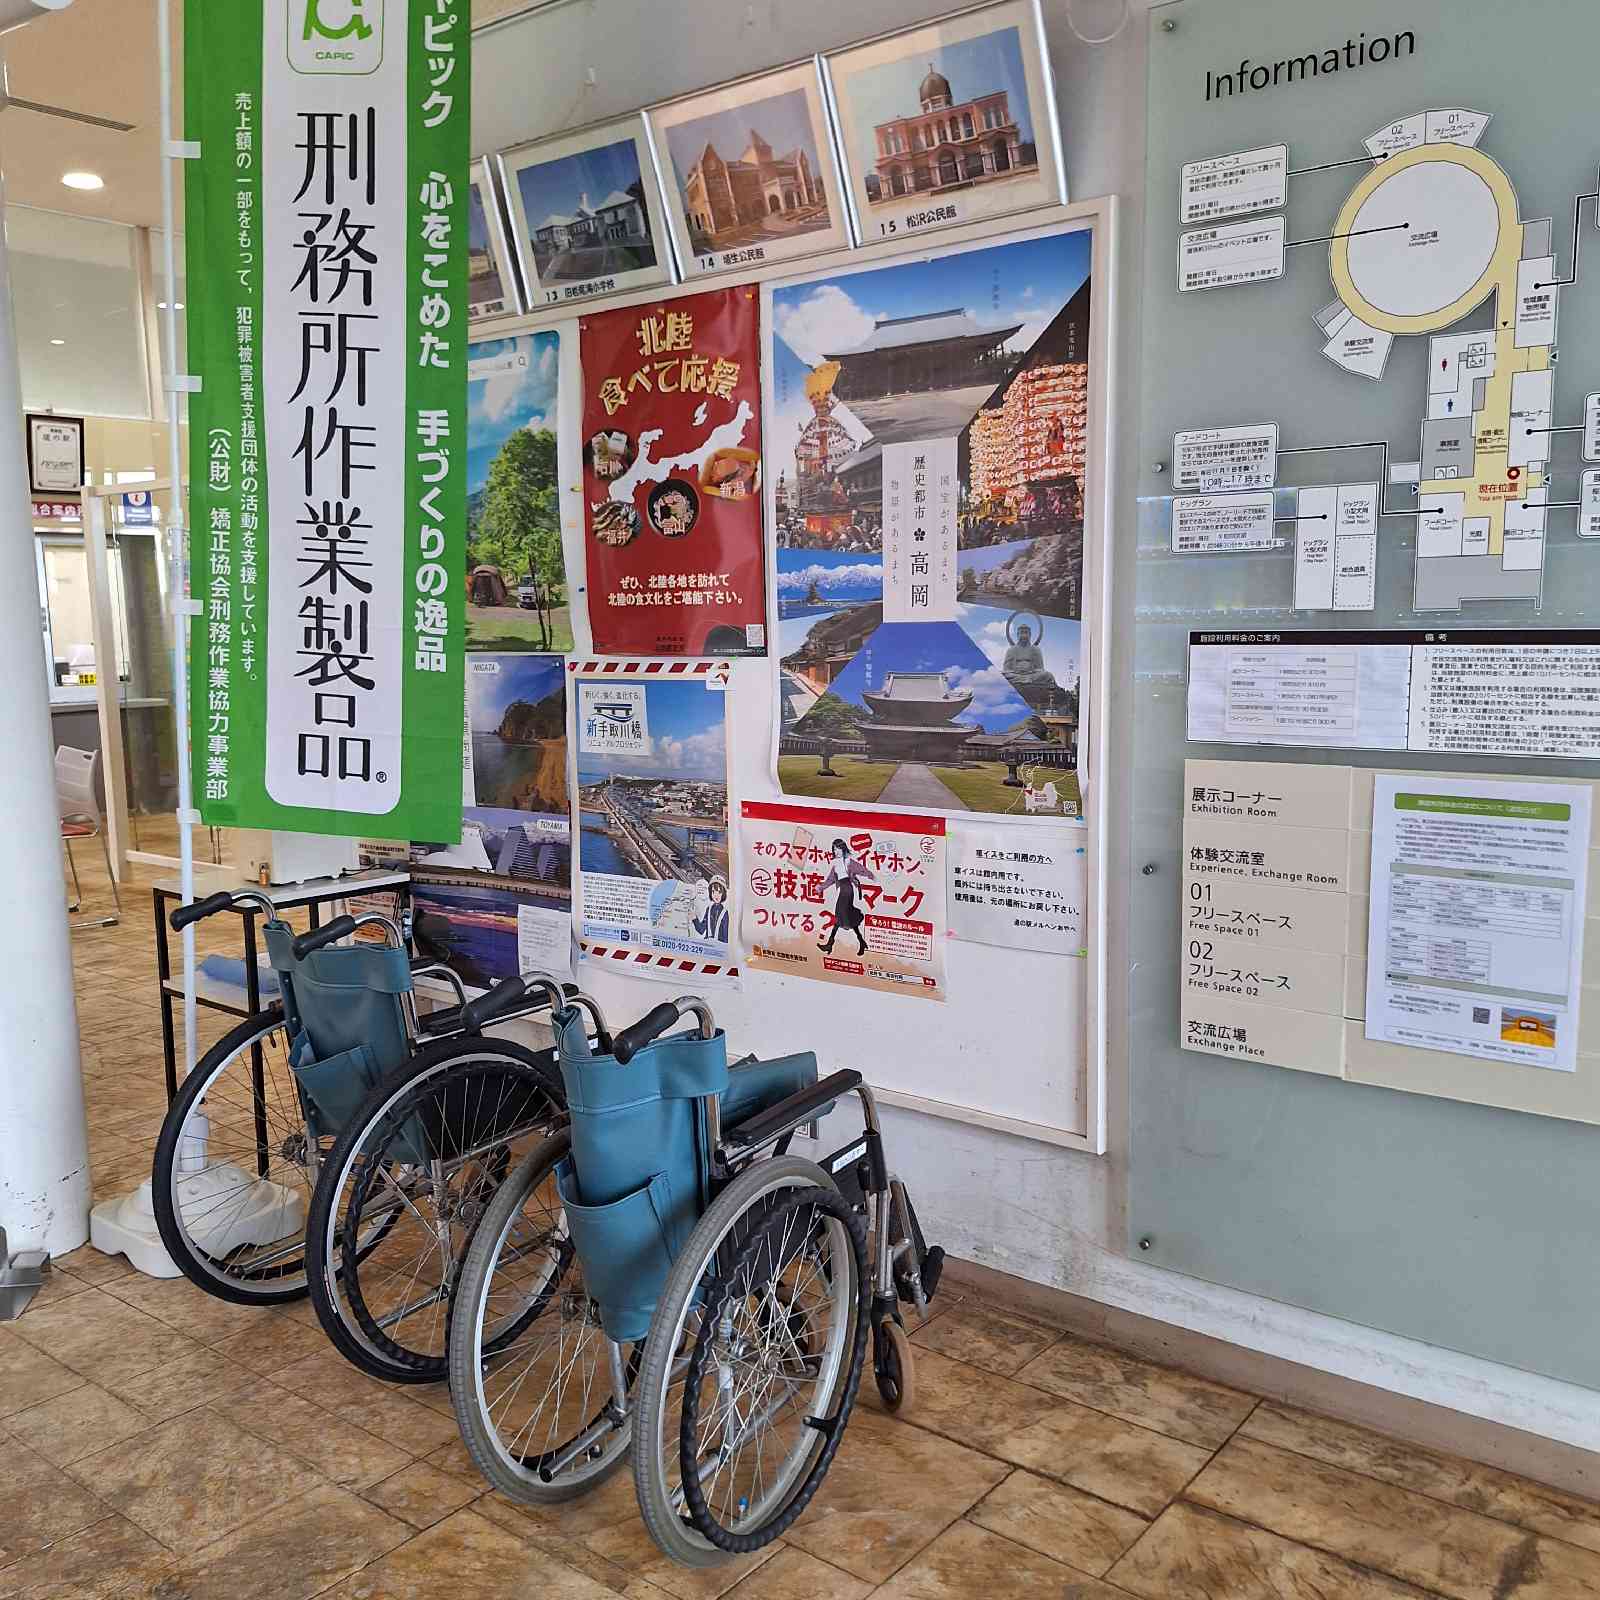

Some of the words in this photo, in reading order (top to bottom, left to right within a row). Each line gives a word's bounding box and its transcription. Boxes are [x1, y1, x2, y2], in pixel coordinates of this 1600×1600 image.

[315, 51, 354, 61] CAPIC
[1204, 30, 1417, 101] Information
[1433, 122, 1475, 136] フリースペース
[1448, 114, 1460, 124] 01
[1378, 133, 1417, 146] フリースペース
[1391, 125, 1403, 135] 02
[881, 221, 897, 236] 15
[906, 204, 957, 230] 松沢公民館
[418, 171, 455, 368] 心をこめた
[701, 257, 715, 269] 14
[546, 291, 558, 302] 13
[636, 312, 694, 356] 北陸
[599, 354, 740, 415] 食べて応援
[290, 106, 382, 783] 刑務所作業製品
[1479, 482, 1520, 494] 現在位置
[415, 408, 450, 673] 手づくりの逸品
[620, 573, 730, 590] ぜひ、北陸各地を訪れて
[910, 551, 929, 609] 高岡
[608, 590, 743, 607] 北陸の食文化をご堪能下さい。
[204, 507, 232, 800] 矯正協会刑務作業協力事業部
[586, 718, 642, 740] 新手取川橋
[1192, 786, 1283, 805] 展示コーナー
[1191, 803, 1243, 816] Exhibition
[1247, 806, 1277, 817] Room
[752, 840, 835, 865] そのスマホや
[857, 851, 925, 876] イヤホン、
[976, 849, 1054, 864] 車イスをご利用の方へ
[1190, 846, 1265, 866] 体験交流室
[954, 866, 1025, 883] 車イスは館内用です。
[1190, 863, 1248, 877] Experience,
[1252, 868, 1303, 883] Exchange
[1306, 873, 1338, 884] Room
[774, 867, 825, 904] 技適
[861, 883, 925, 918] マーク
[954, 879, 1065, 901] 館外には持ち出さないで下さい。
[1190, 882, 1212, 902] 01
[954, 892, 1081, 917] 使用後は、元の場所にお戻し下さい。
[1190, 905, 1293, 930] フリースペース
[1189, 920, 1210, 931] Free
[1214, 923, 1244, 936] Space
[1247, 927, 1260, 937] 01
[1189, 940, 1214, 960] 02
[1189, 963, 1292, 991] フリースペース
[1188, 978, 1209, 989] Free
[1213, 981, 1243, 995] Space
[1246, 986, 1259, 997] 02
[1187, 1020, 1247, 1043] 交流広場
[1187, 1036, 1235, 1052] Exchange
[1239, 1044, 1266, 1058] Place
